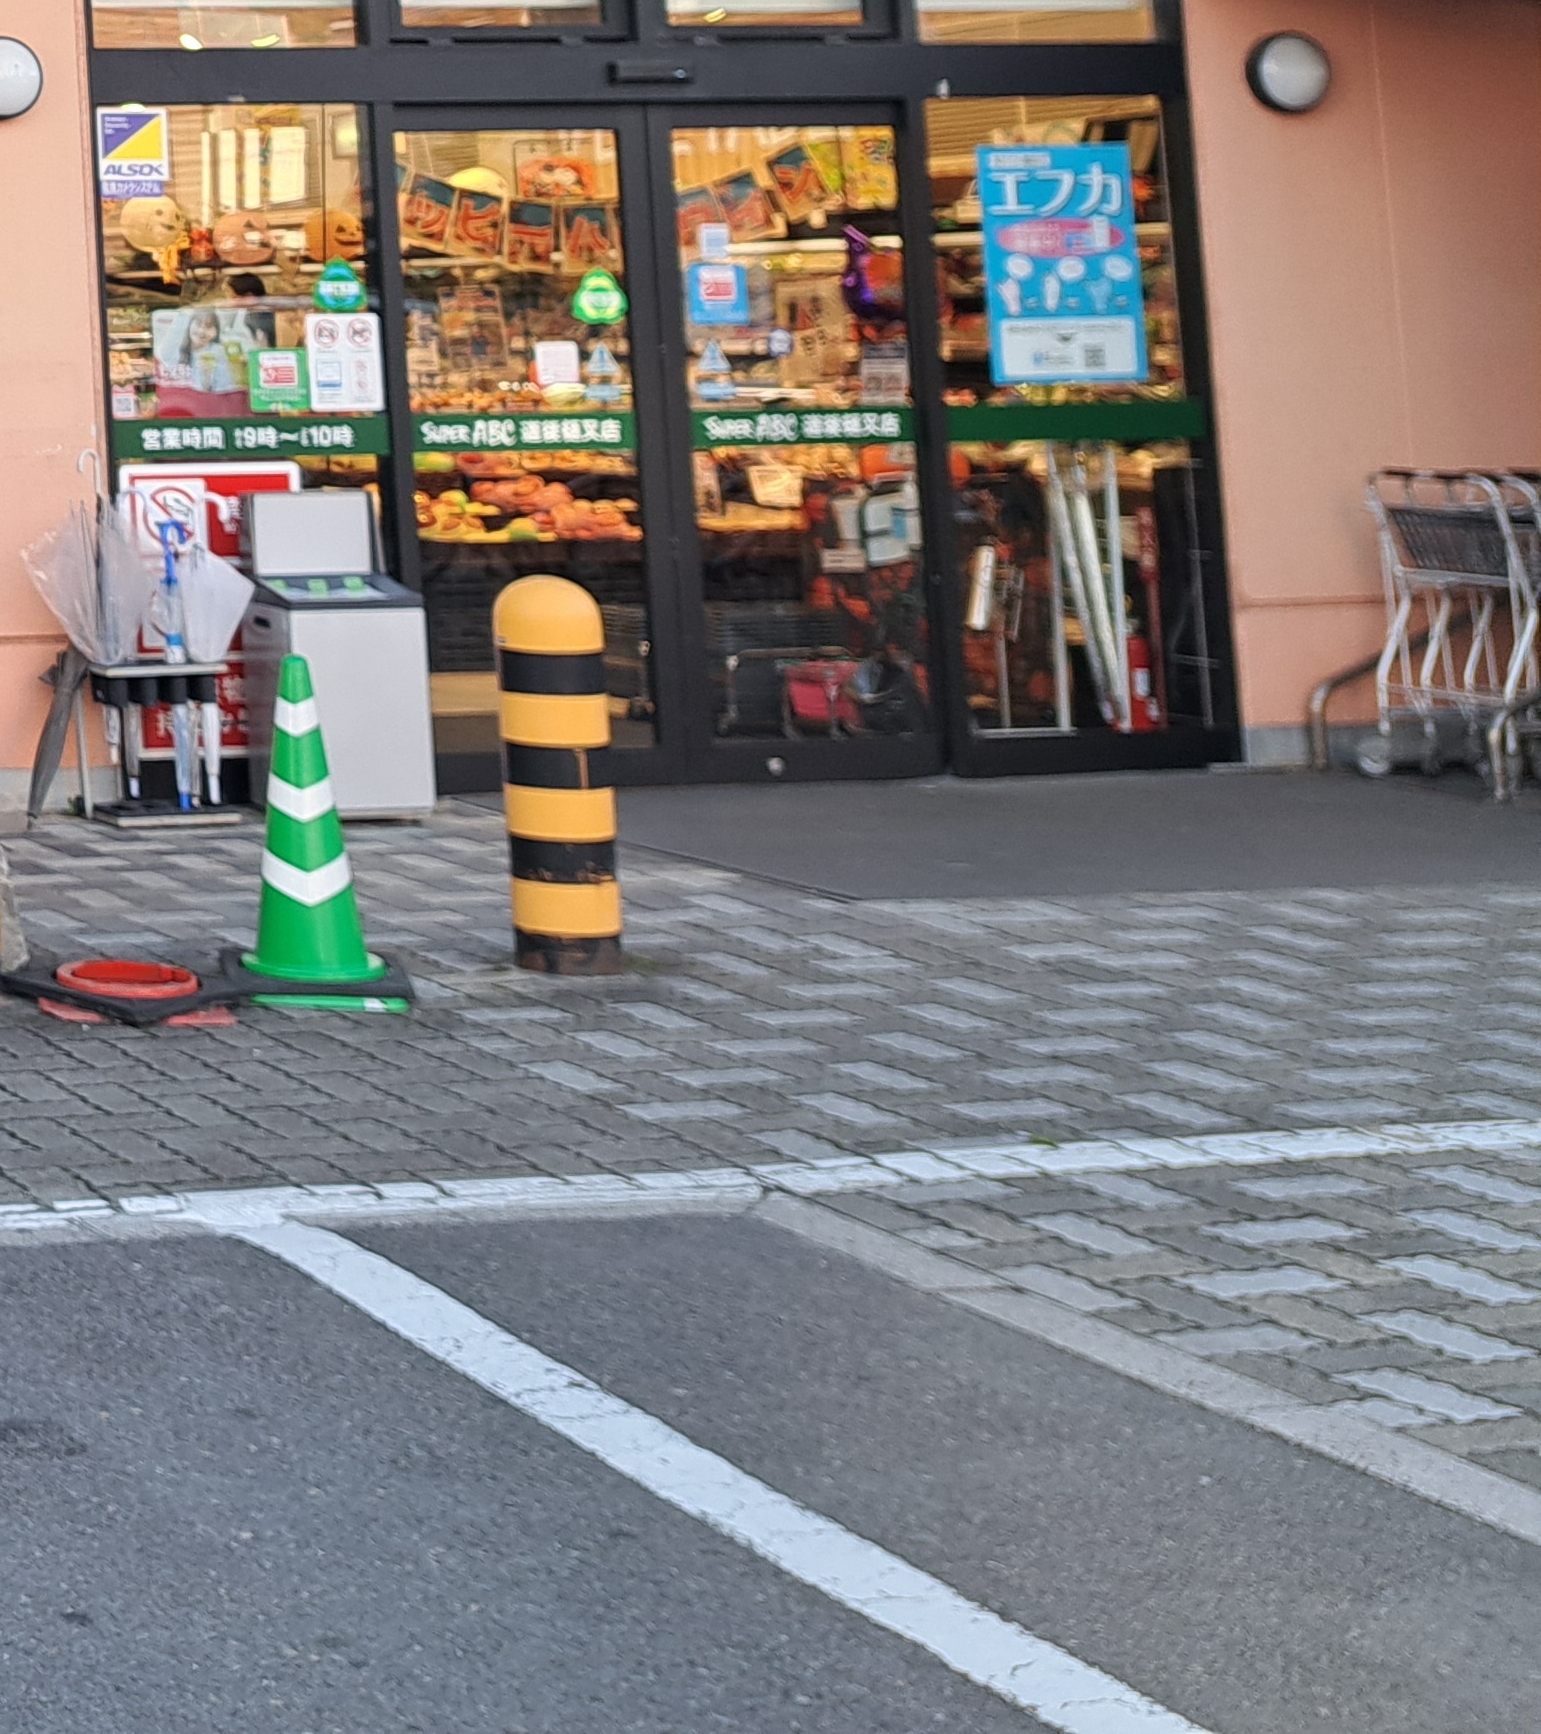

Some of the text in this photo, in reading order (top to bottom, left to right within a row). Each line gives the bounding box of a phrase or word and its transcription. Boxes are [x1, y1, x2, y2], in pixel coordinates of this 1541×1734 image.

[103, 163, 164, 177] ALSOK
[987, 161, 1123, 217] エフカ
[141, 426, 226, 451] 営業時間
[472, 419, 516, 446] ABC
